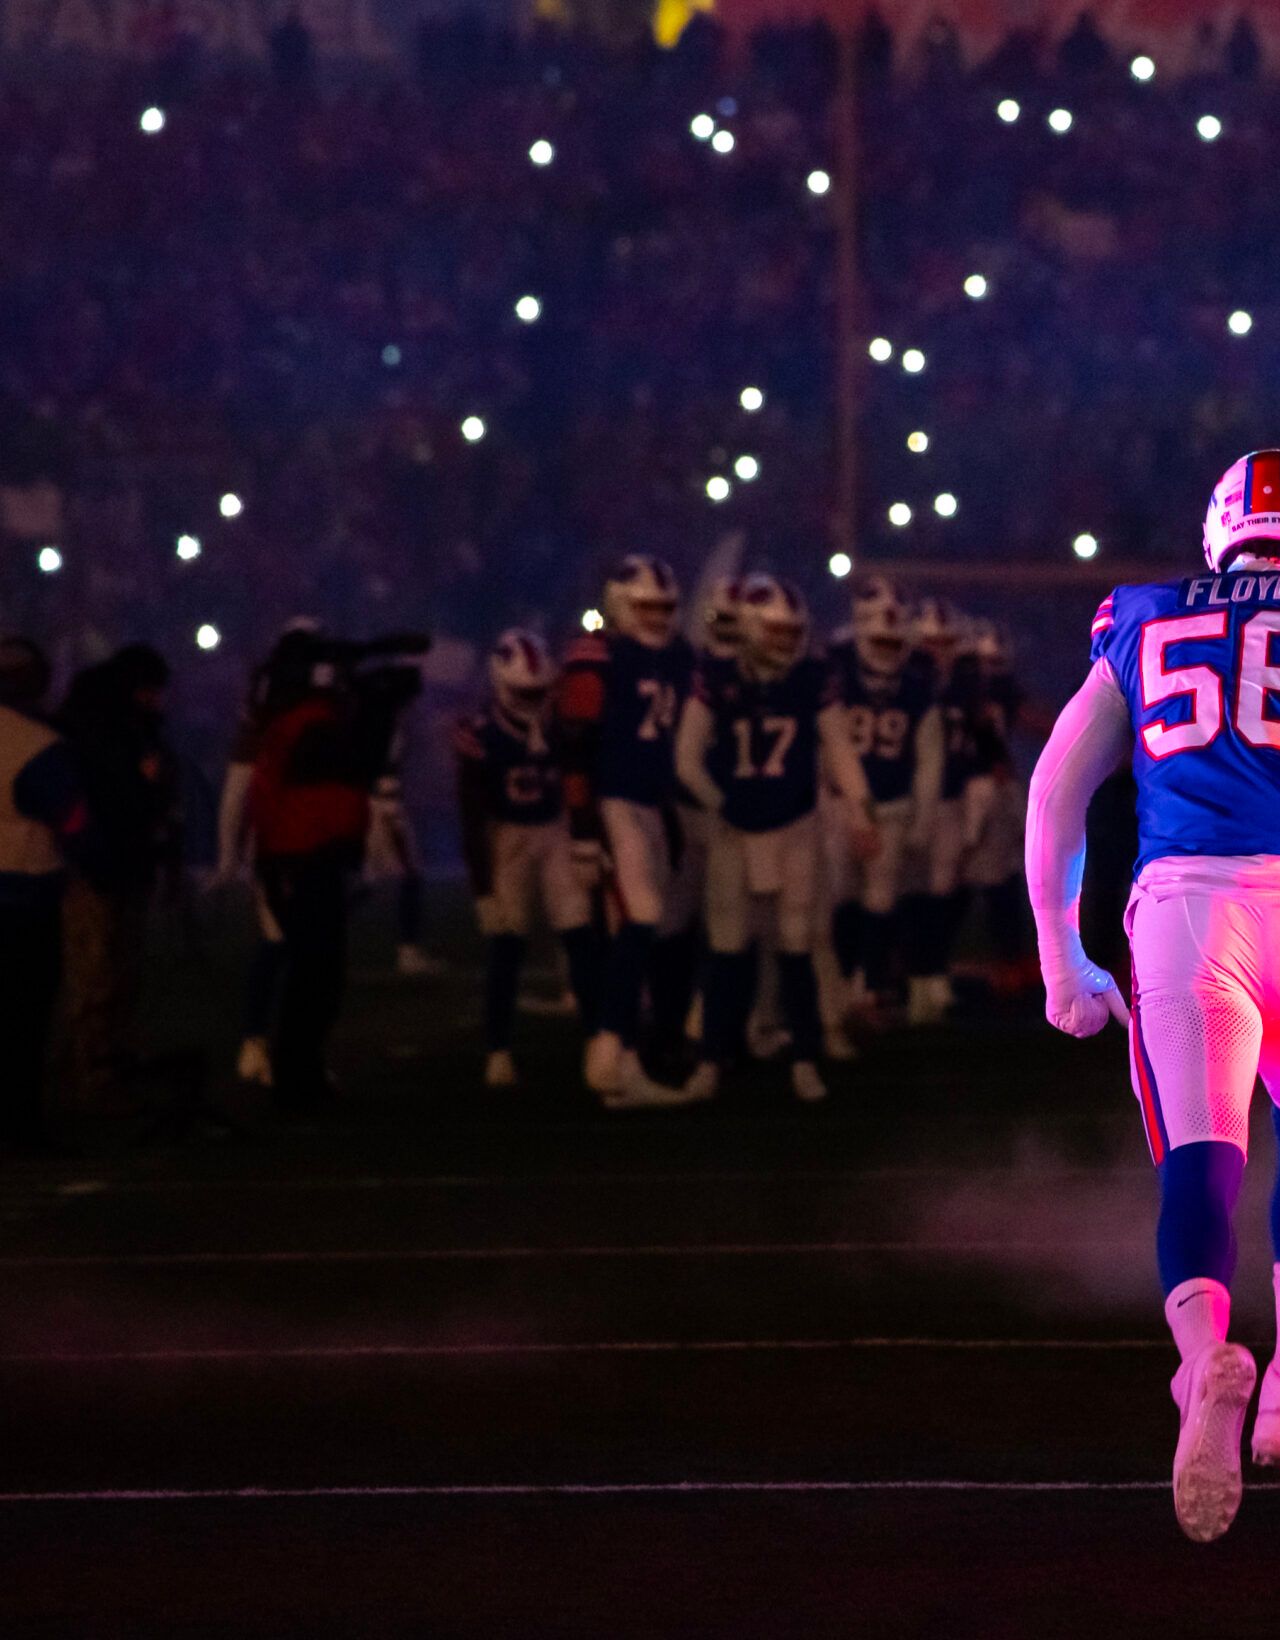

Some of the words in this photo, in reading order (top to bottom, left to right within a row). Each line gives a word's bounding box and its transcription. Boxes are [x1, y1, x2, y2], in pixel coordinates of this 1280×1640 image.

[1232, 523, 1245, 532] SAY
[1247, 517, 1269, 526] THEIR
[731, 715, 799, 779] 17
